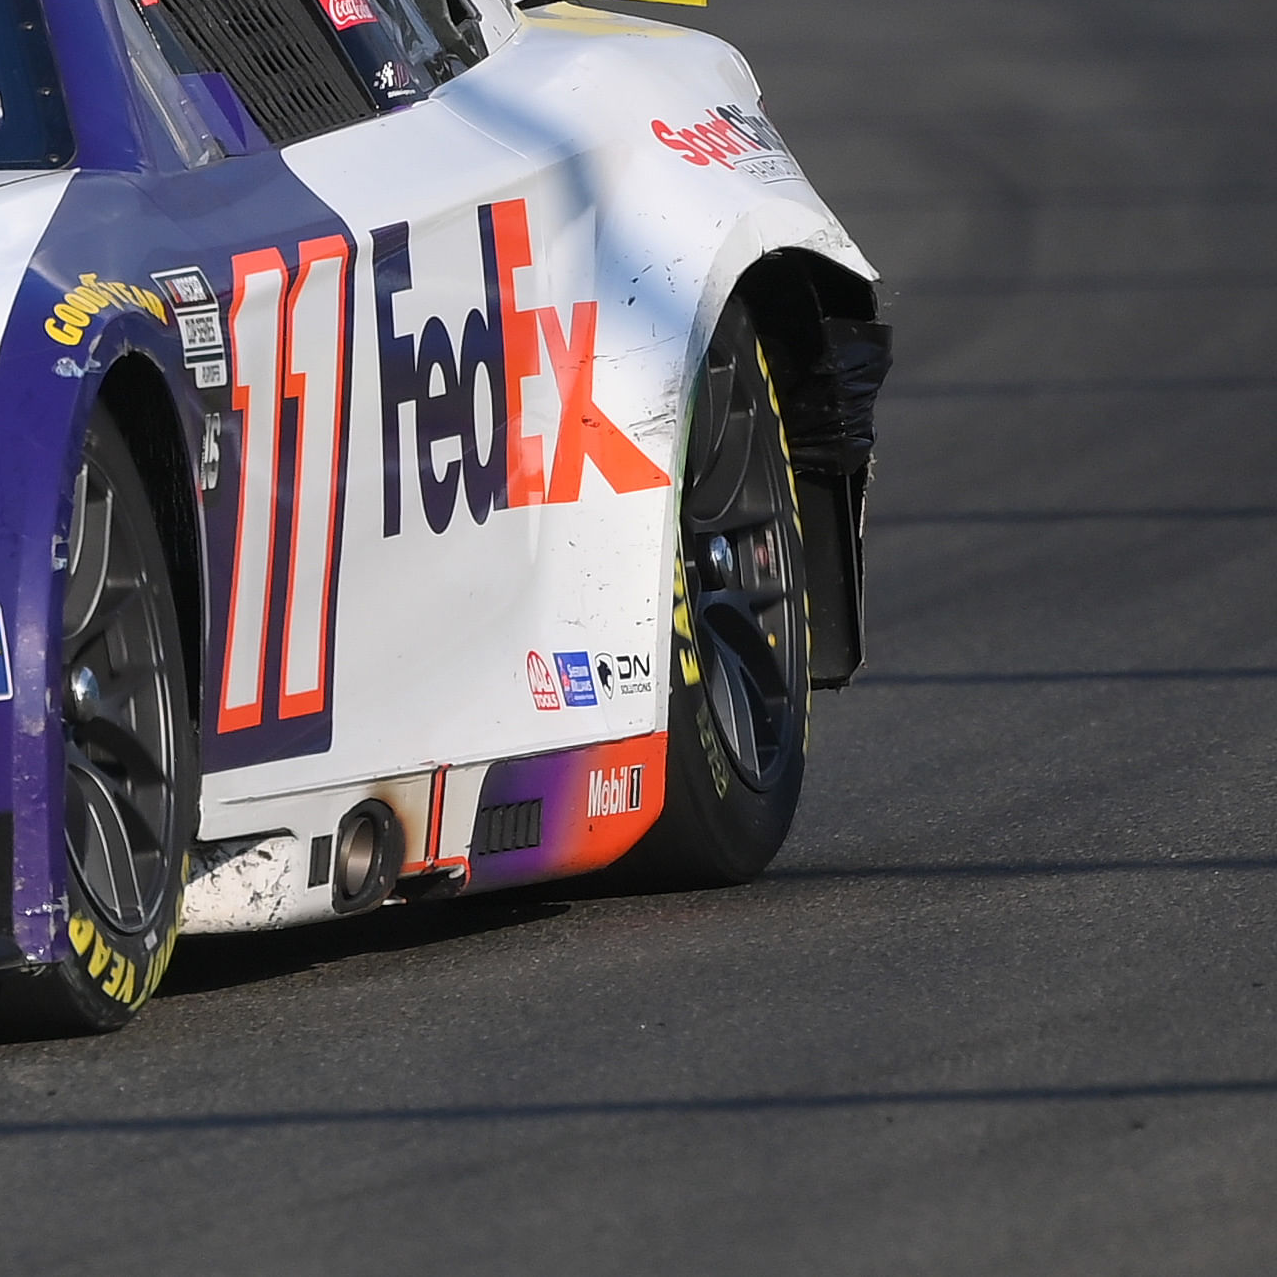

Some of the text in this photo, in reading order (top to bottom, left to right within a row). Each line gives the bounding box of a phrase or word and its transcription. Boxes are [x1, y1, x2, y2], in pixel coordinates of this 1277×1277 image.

[370, 198, 672, 539] FedEx
[217, 234, 354, 734] 11
[615, 652, 651, 680] DN
[588, 766, 628, 818] Mobil
